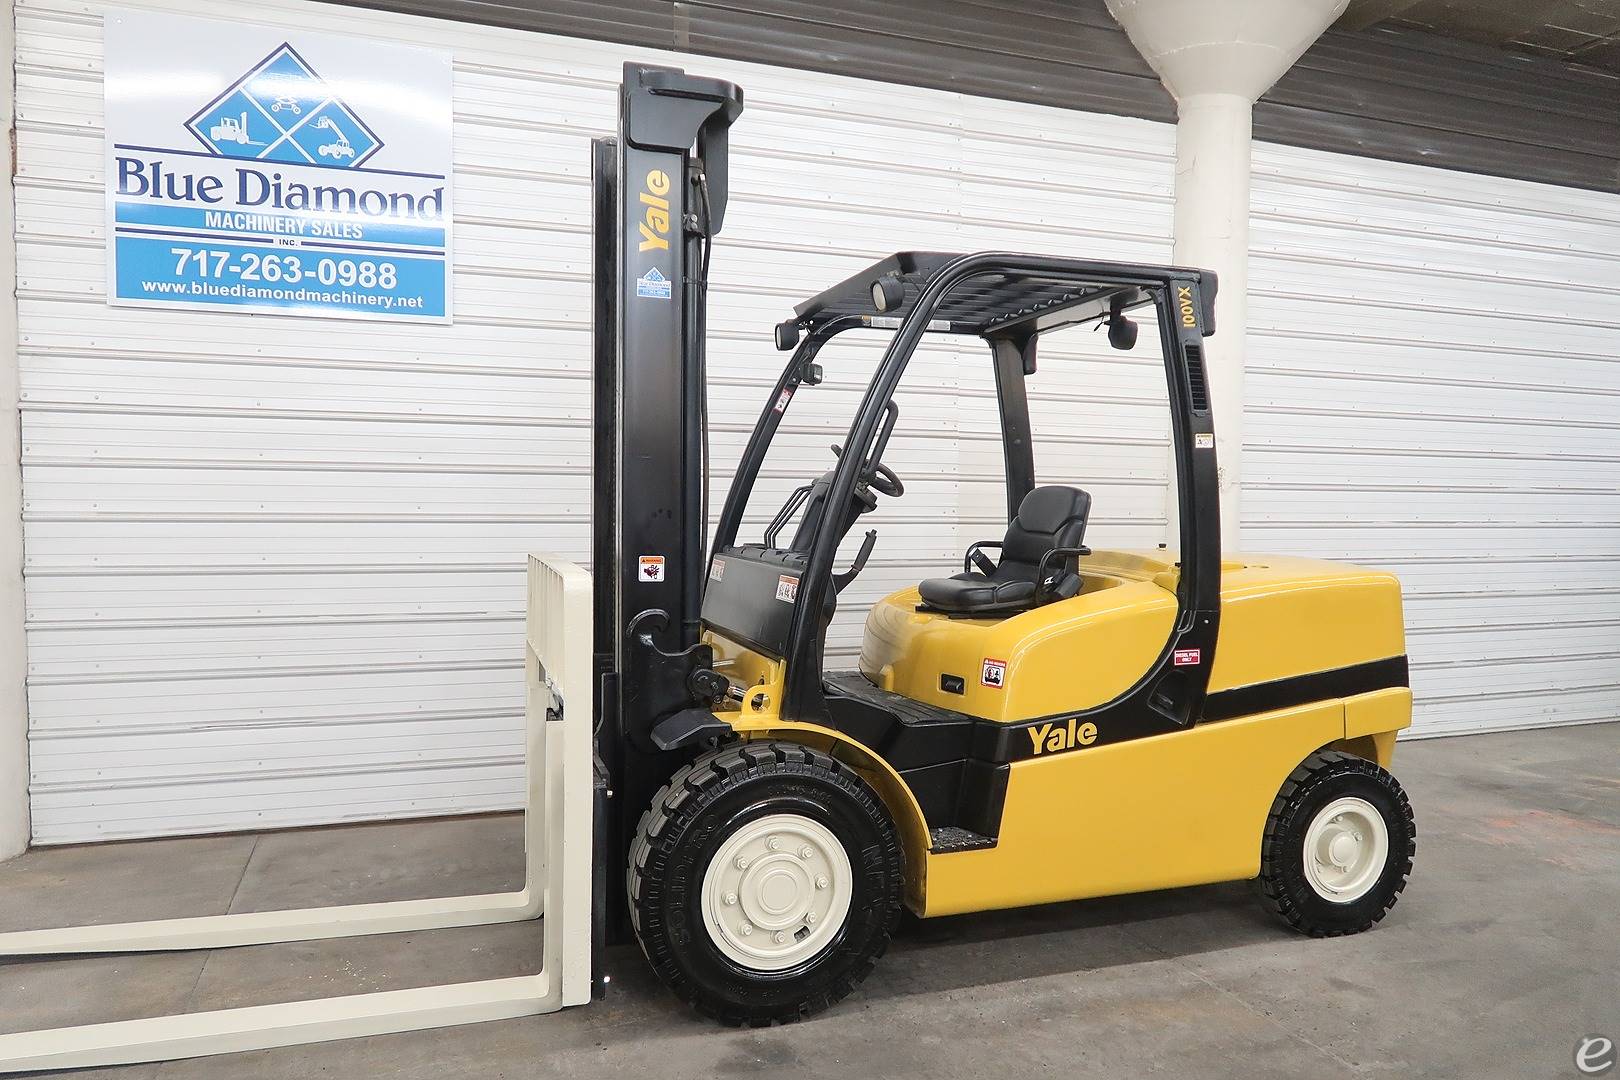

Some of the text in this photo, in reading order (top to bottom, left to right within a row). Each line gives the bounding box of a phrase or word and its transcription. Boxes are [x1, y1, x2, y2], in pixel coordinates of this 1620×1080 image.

[115, 156, 444, 220] Blue Diamond
[205, 211, 363, 239] MACHINERY SALES
[639, 169, 670, 251] Yale
[279, 239, 298, 247] INC.
[171, 248, 397, 289] 717-263-0988
[142, 280, 423, 308] www.bluediamondmachinery.net
[1178, 286, 1196, 328] 100VX
[1027, 718, 1098, 755] Yale
